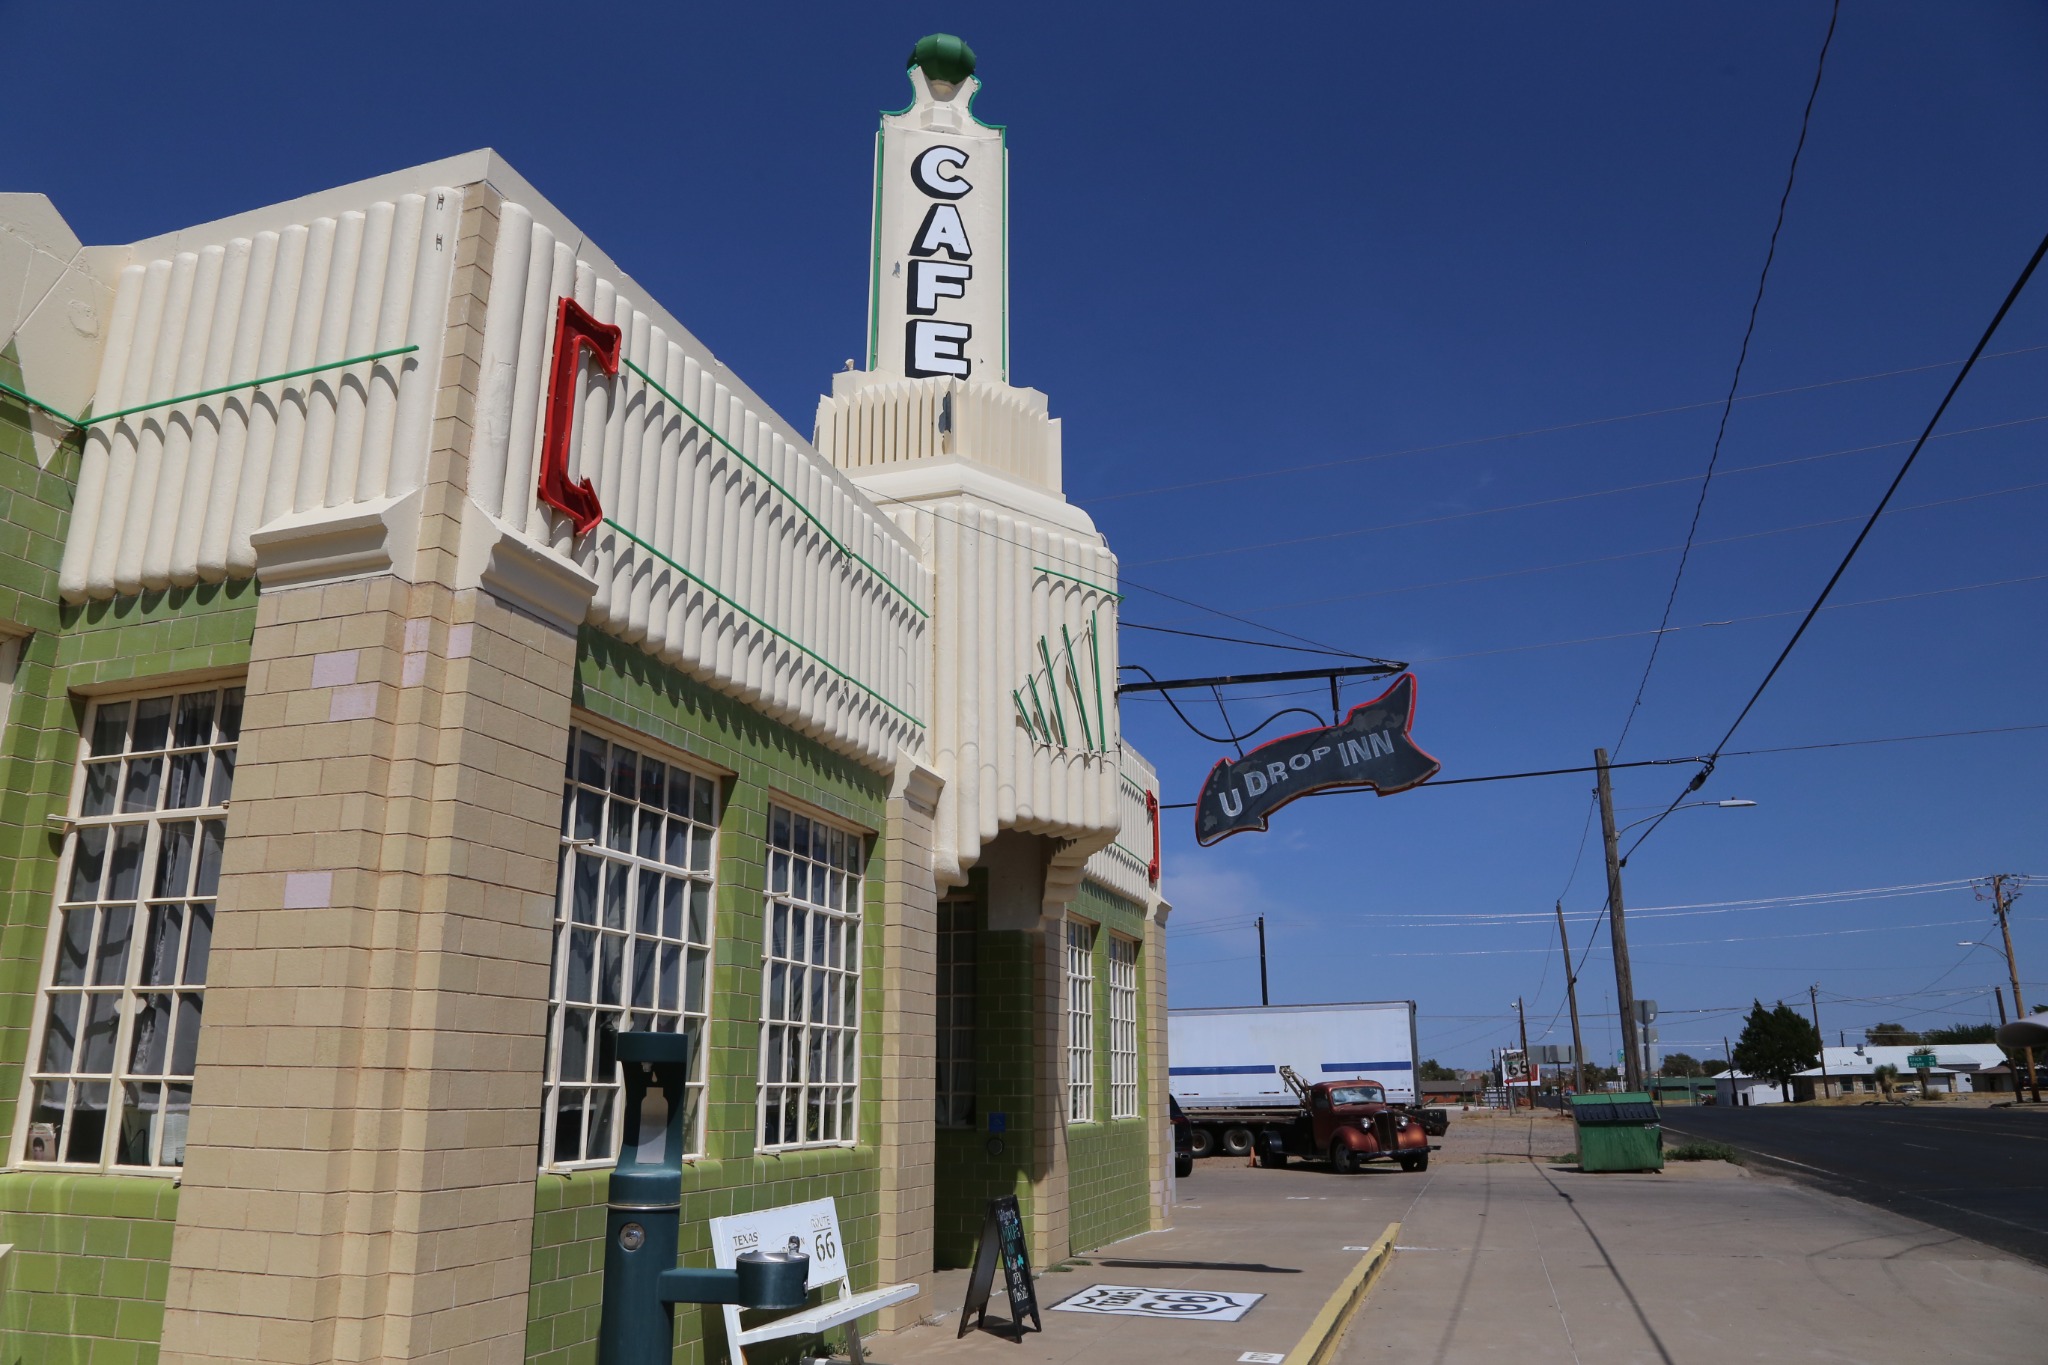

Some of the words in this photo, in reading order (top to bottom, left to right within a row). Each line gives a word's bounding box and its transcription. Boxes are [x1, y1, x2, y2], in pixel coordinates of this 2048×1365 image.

[905, 145, 973, 381] CAFE
[1218, 788, 1243, 817] U
[1244, 746, 1331, 797] DROP
[1338, 730, 1394, 767] INN
[1508, 1060, 1529, 1076] 66
[733, 1231, 759, 1247] TEXAS
[815, 1231, 836, 1262] 66
[1096, 1290, 1144, 1307] TEXAS
[1141, 1294, 1218, 1312] 66
